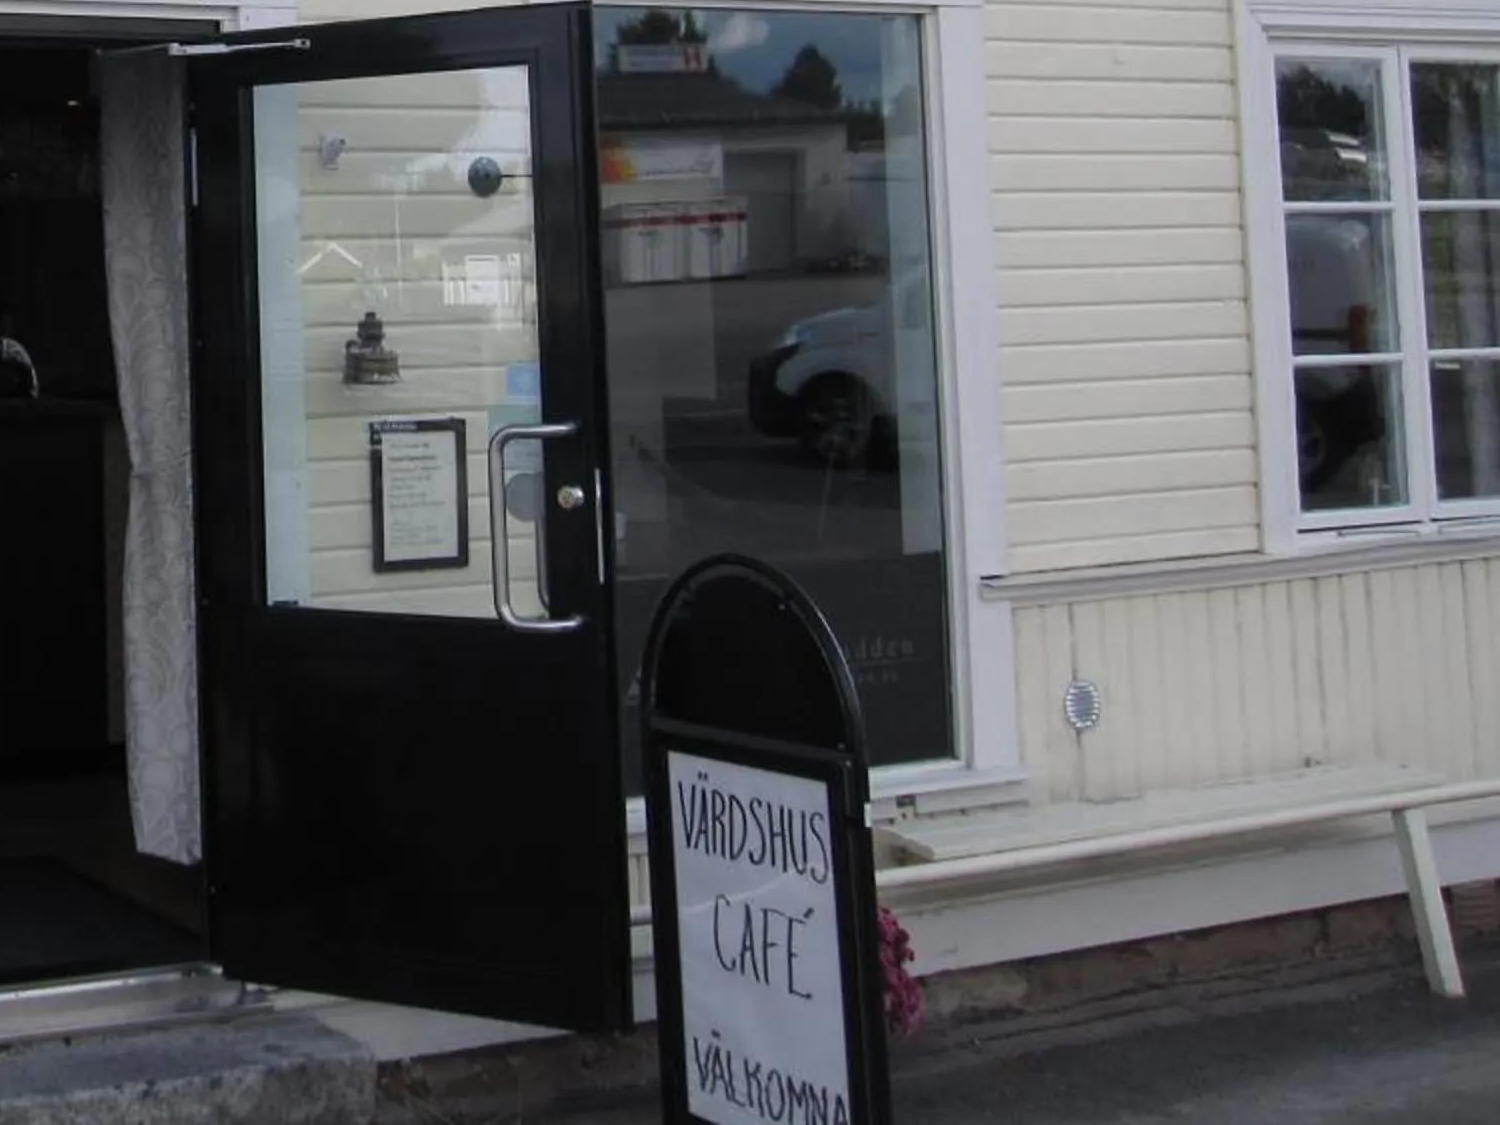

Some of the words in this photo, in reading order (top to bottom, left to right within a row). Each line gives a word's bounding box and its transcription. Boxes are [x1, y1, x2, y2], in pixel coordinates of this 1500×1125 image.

[678, 772, 829, 884] VÄRDSHUS
[713, 893, 813, 1000] CAFÉ
[692, 1028, 849, 1125] VÄLKOMNA
